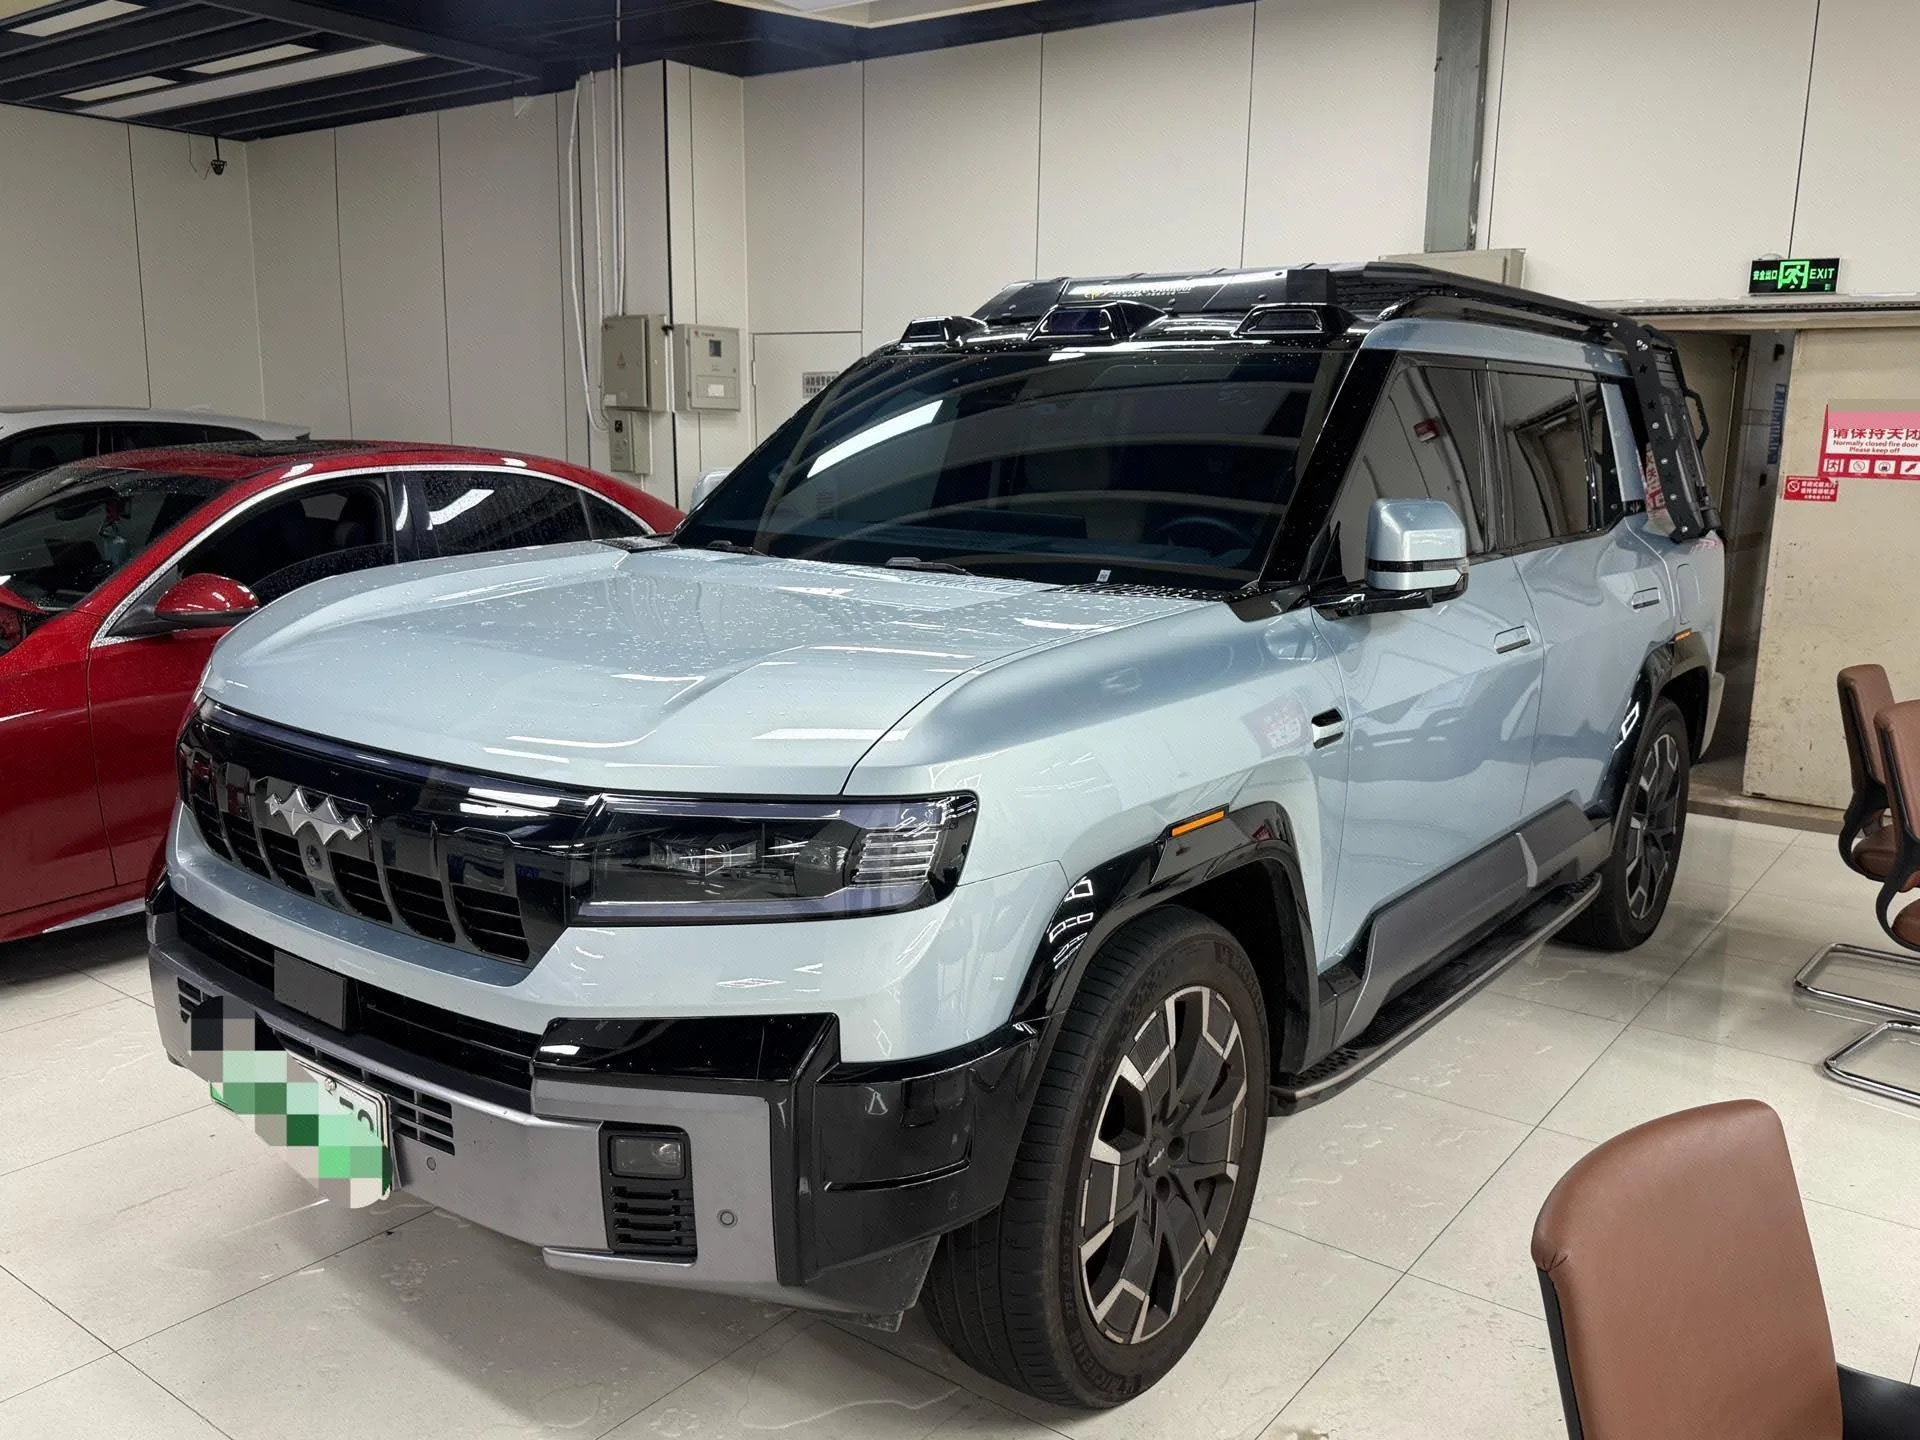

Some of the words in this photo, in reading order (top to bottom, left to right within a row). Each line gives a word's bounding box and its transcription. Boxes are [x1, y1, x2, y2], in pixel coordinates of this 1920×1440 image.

[1753, 270, 1778, 280] 安全出口
[1809, 268, 1835, 279] EXIT
